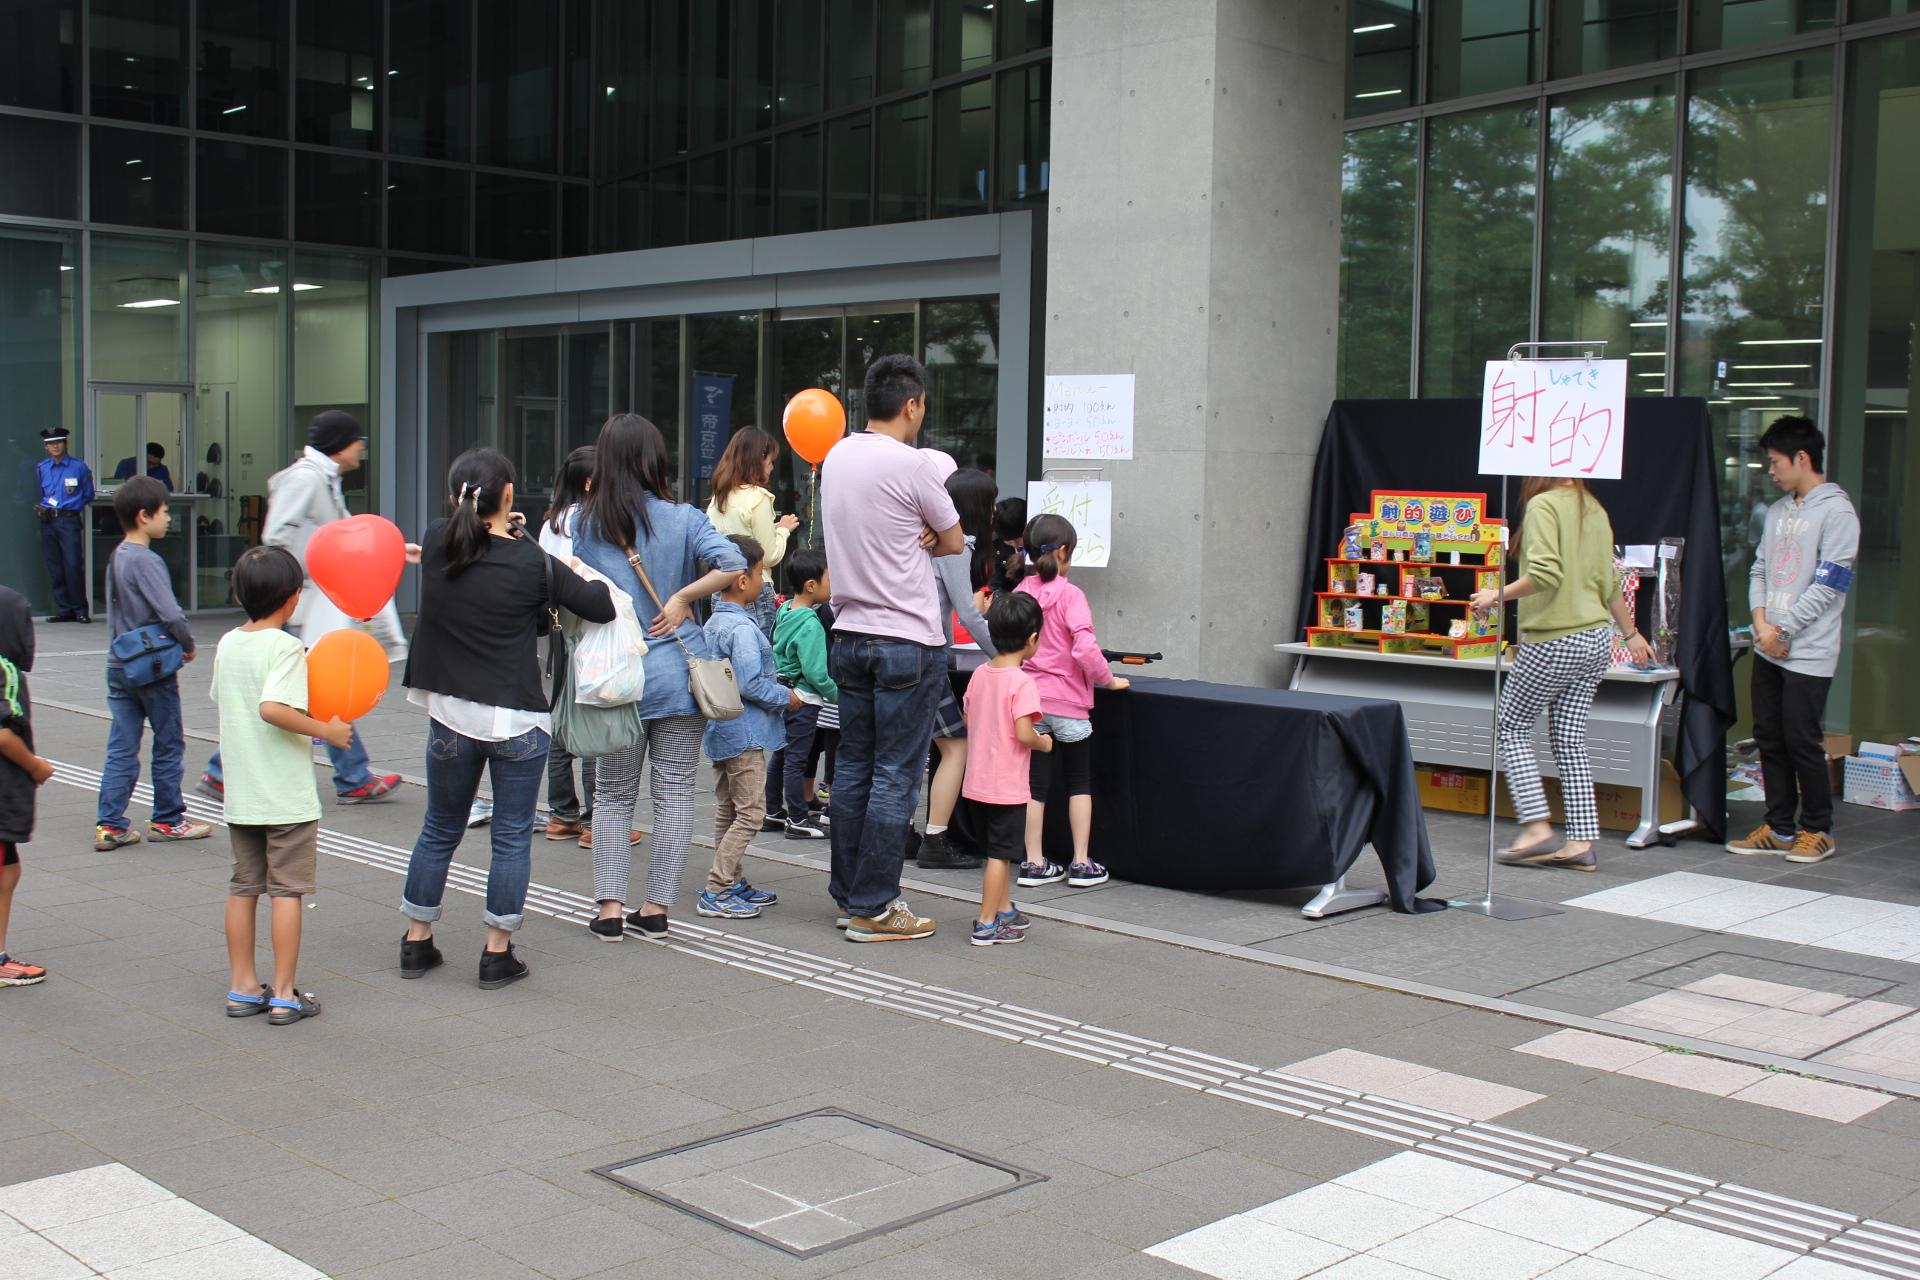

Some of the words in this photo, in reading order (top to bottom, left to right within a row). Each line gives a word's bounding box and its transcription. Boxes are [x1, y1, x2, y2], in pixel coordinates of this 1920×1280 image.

[1550, 368, 1601, 389] しゃてき
[1485, 368, 1612, 474] 射的
[1380, 503, 1476, 524] 射的遊び
